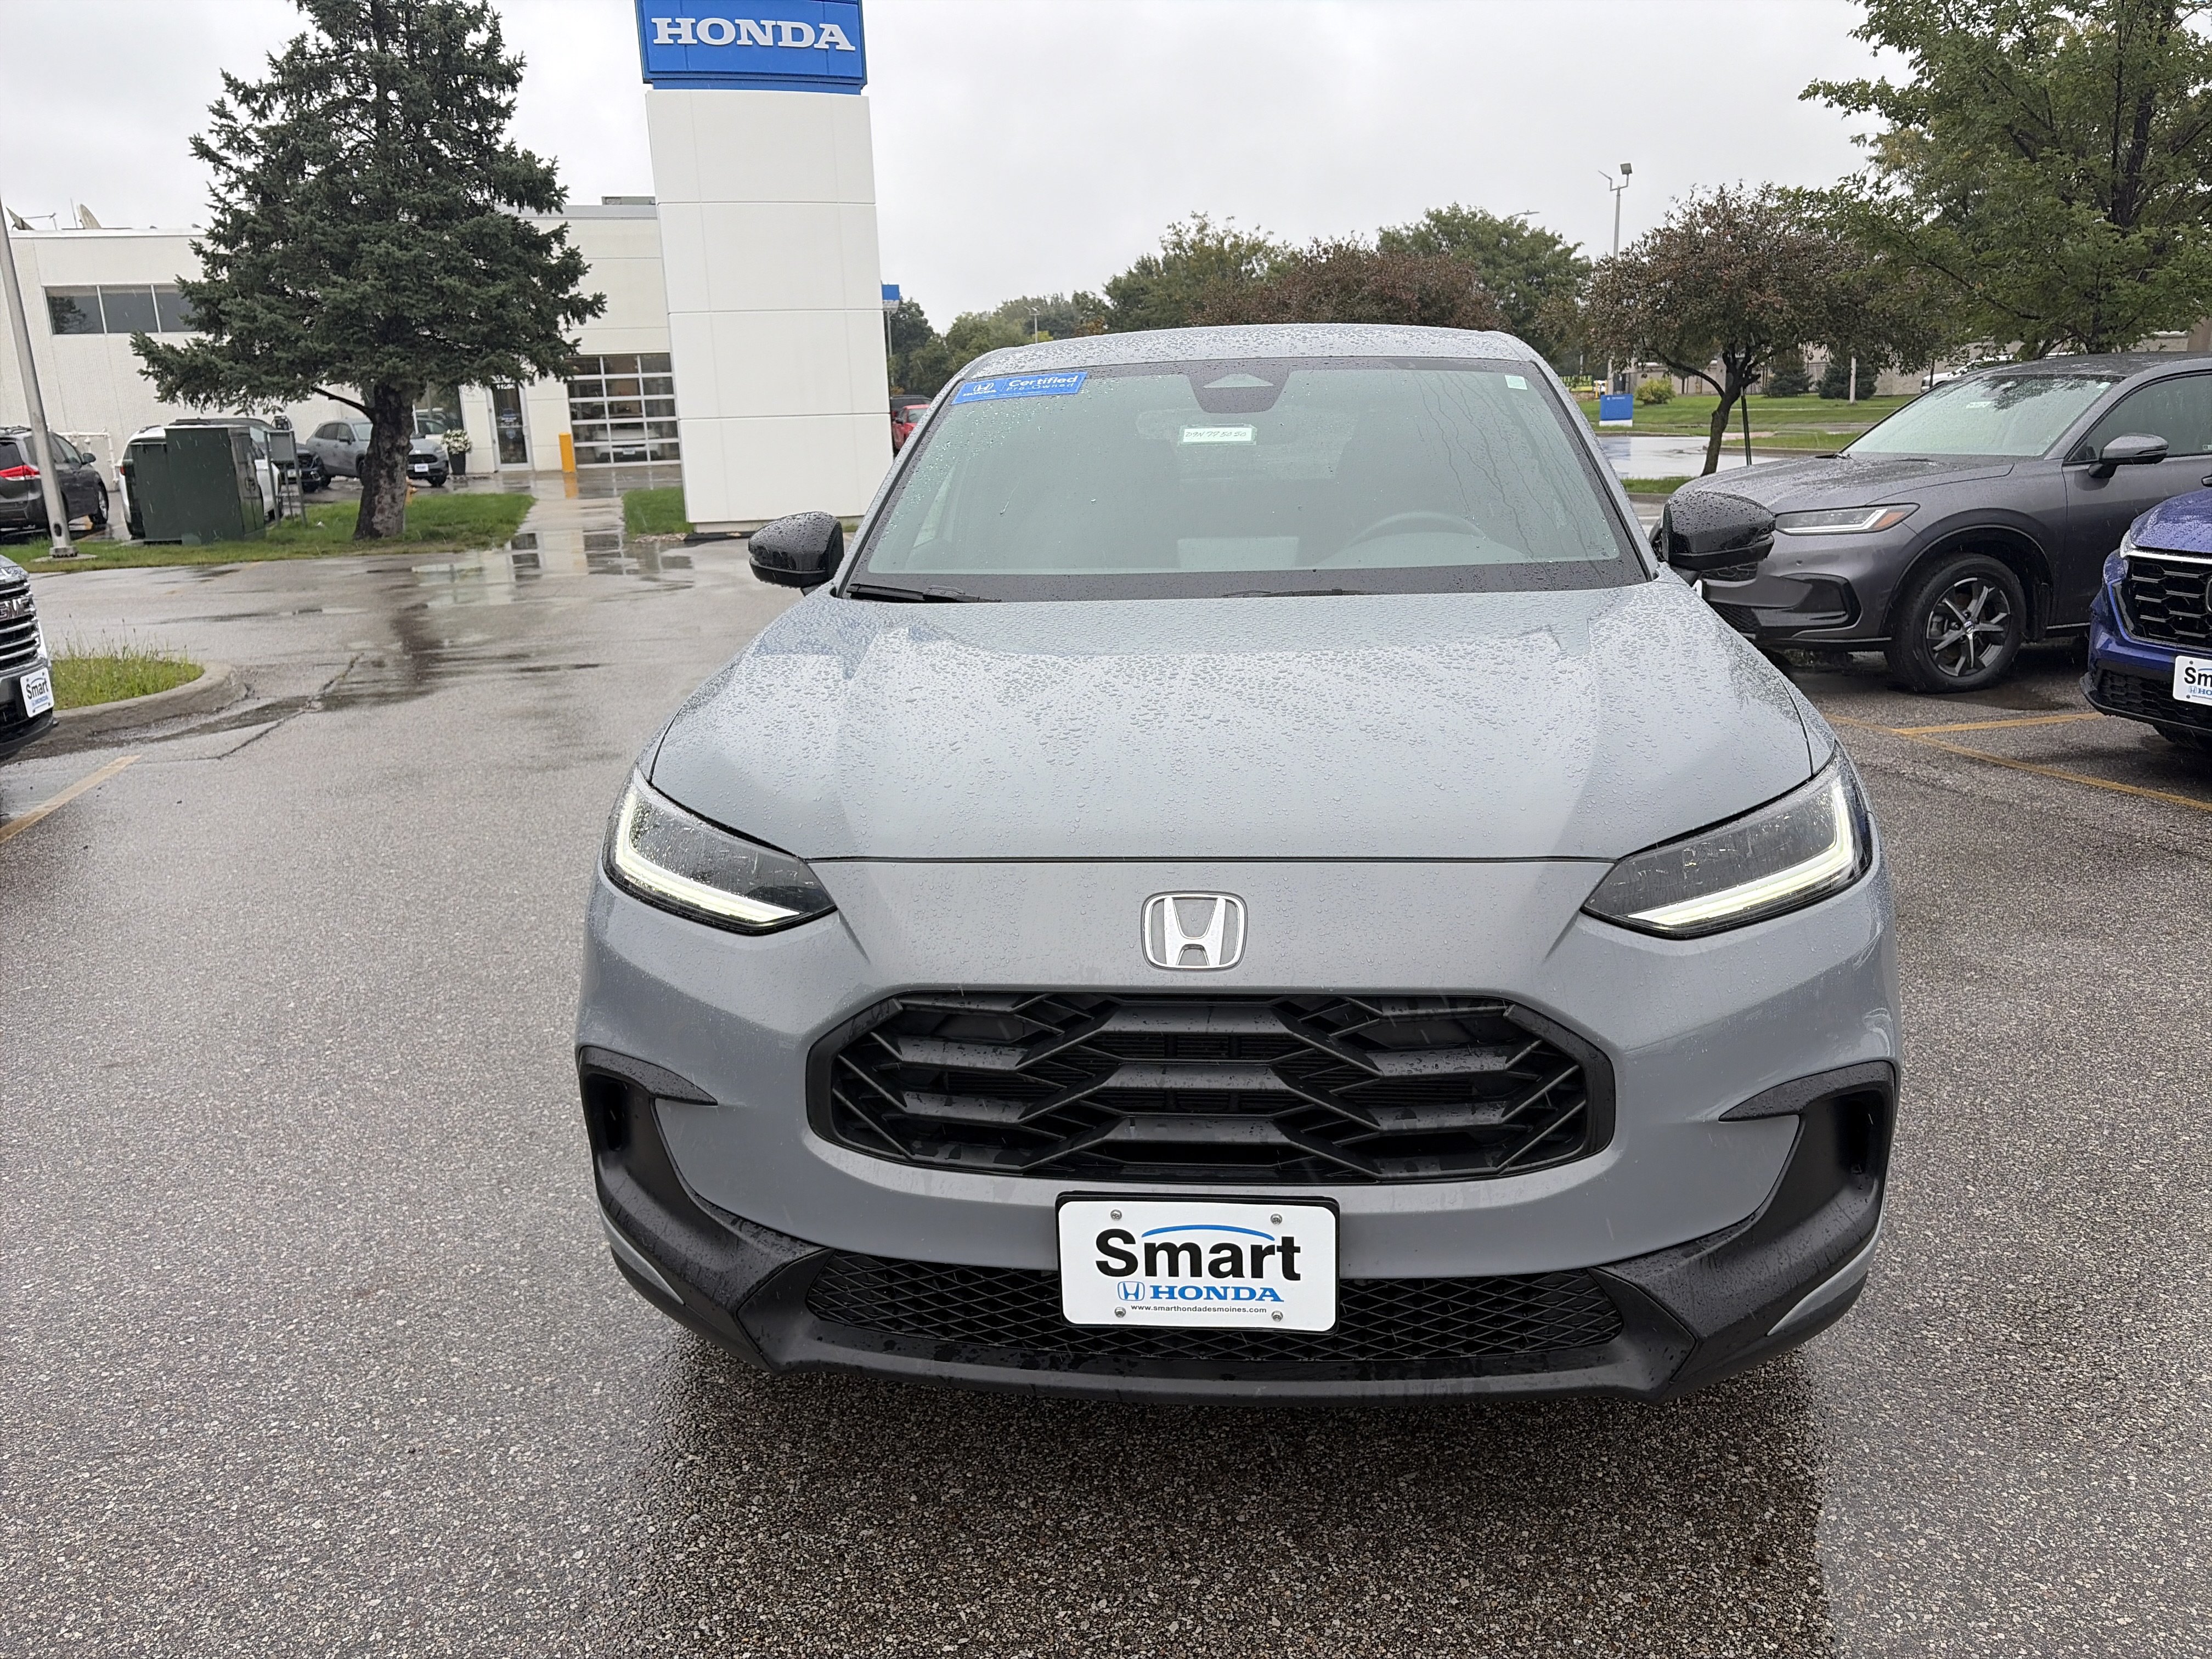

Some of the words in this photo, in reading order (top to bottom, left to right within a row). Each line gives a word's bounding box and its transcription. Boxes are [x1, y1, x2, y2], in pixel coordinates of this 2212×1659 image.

[651, 18, 855, 51] HONDA
[1009, 375, 1079, 387] Certified
[26, 678, 49, 699] Smart
[1095, 1228, 1301, 1281] Smart
[1149, 1285, 1284, 1302] HONDA
[1131, 1305, 1267, 1313] www.smarthondadesmoines.com
